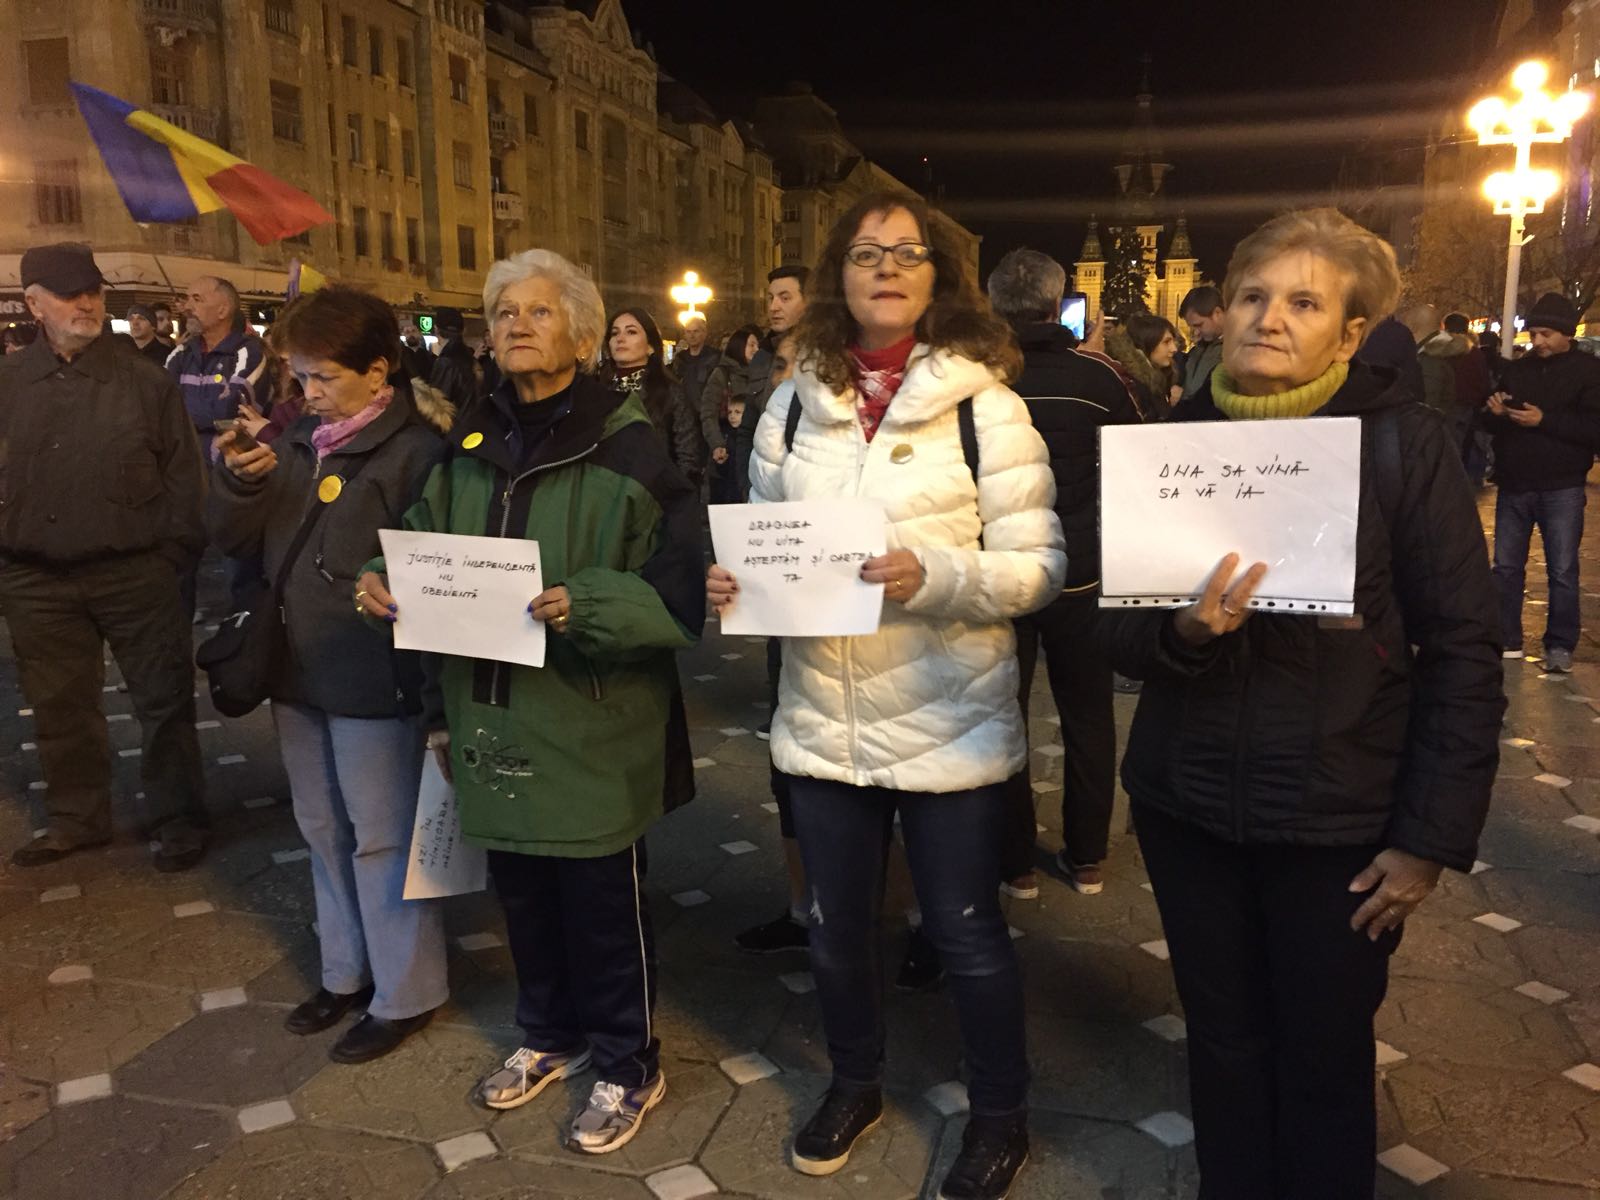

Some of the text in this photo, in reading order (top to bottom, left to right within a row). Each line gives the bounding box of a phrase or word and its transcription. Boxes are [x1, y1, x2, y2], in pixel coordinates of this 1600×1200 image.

[1159, 463, 1204, 478] DNA
[1221, 464, 1246, 478] SA
[1159, 487, 1180, 499] SA
[1235, 482, 1265, 499] IA
[748, 538, 764, 547] NU
[438, 573, 455, 582] NU
[783, 573, 803, 583] TA
